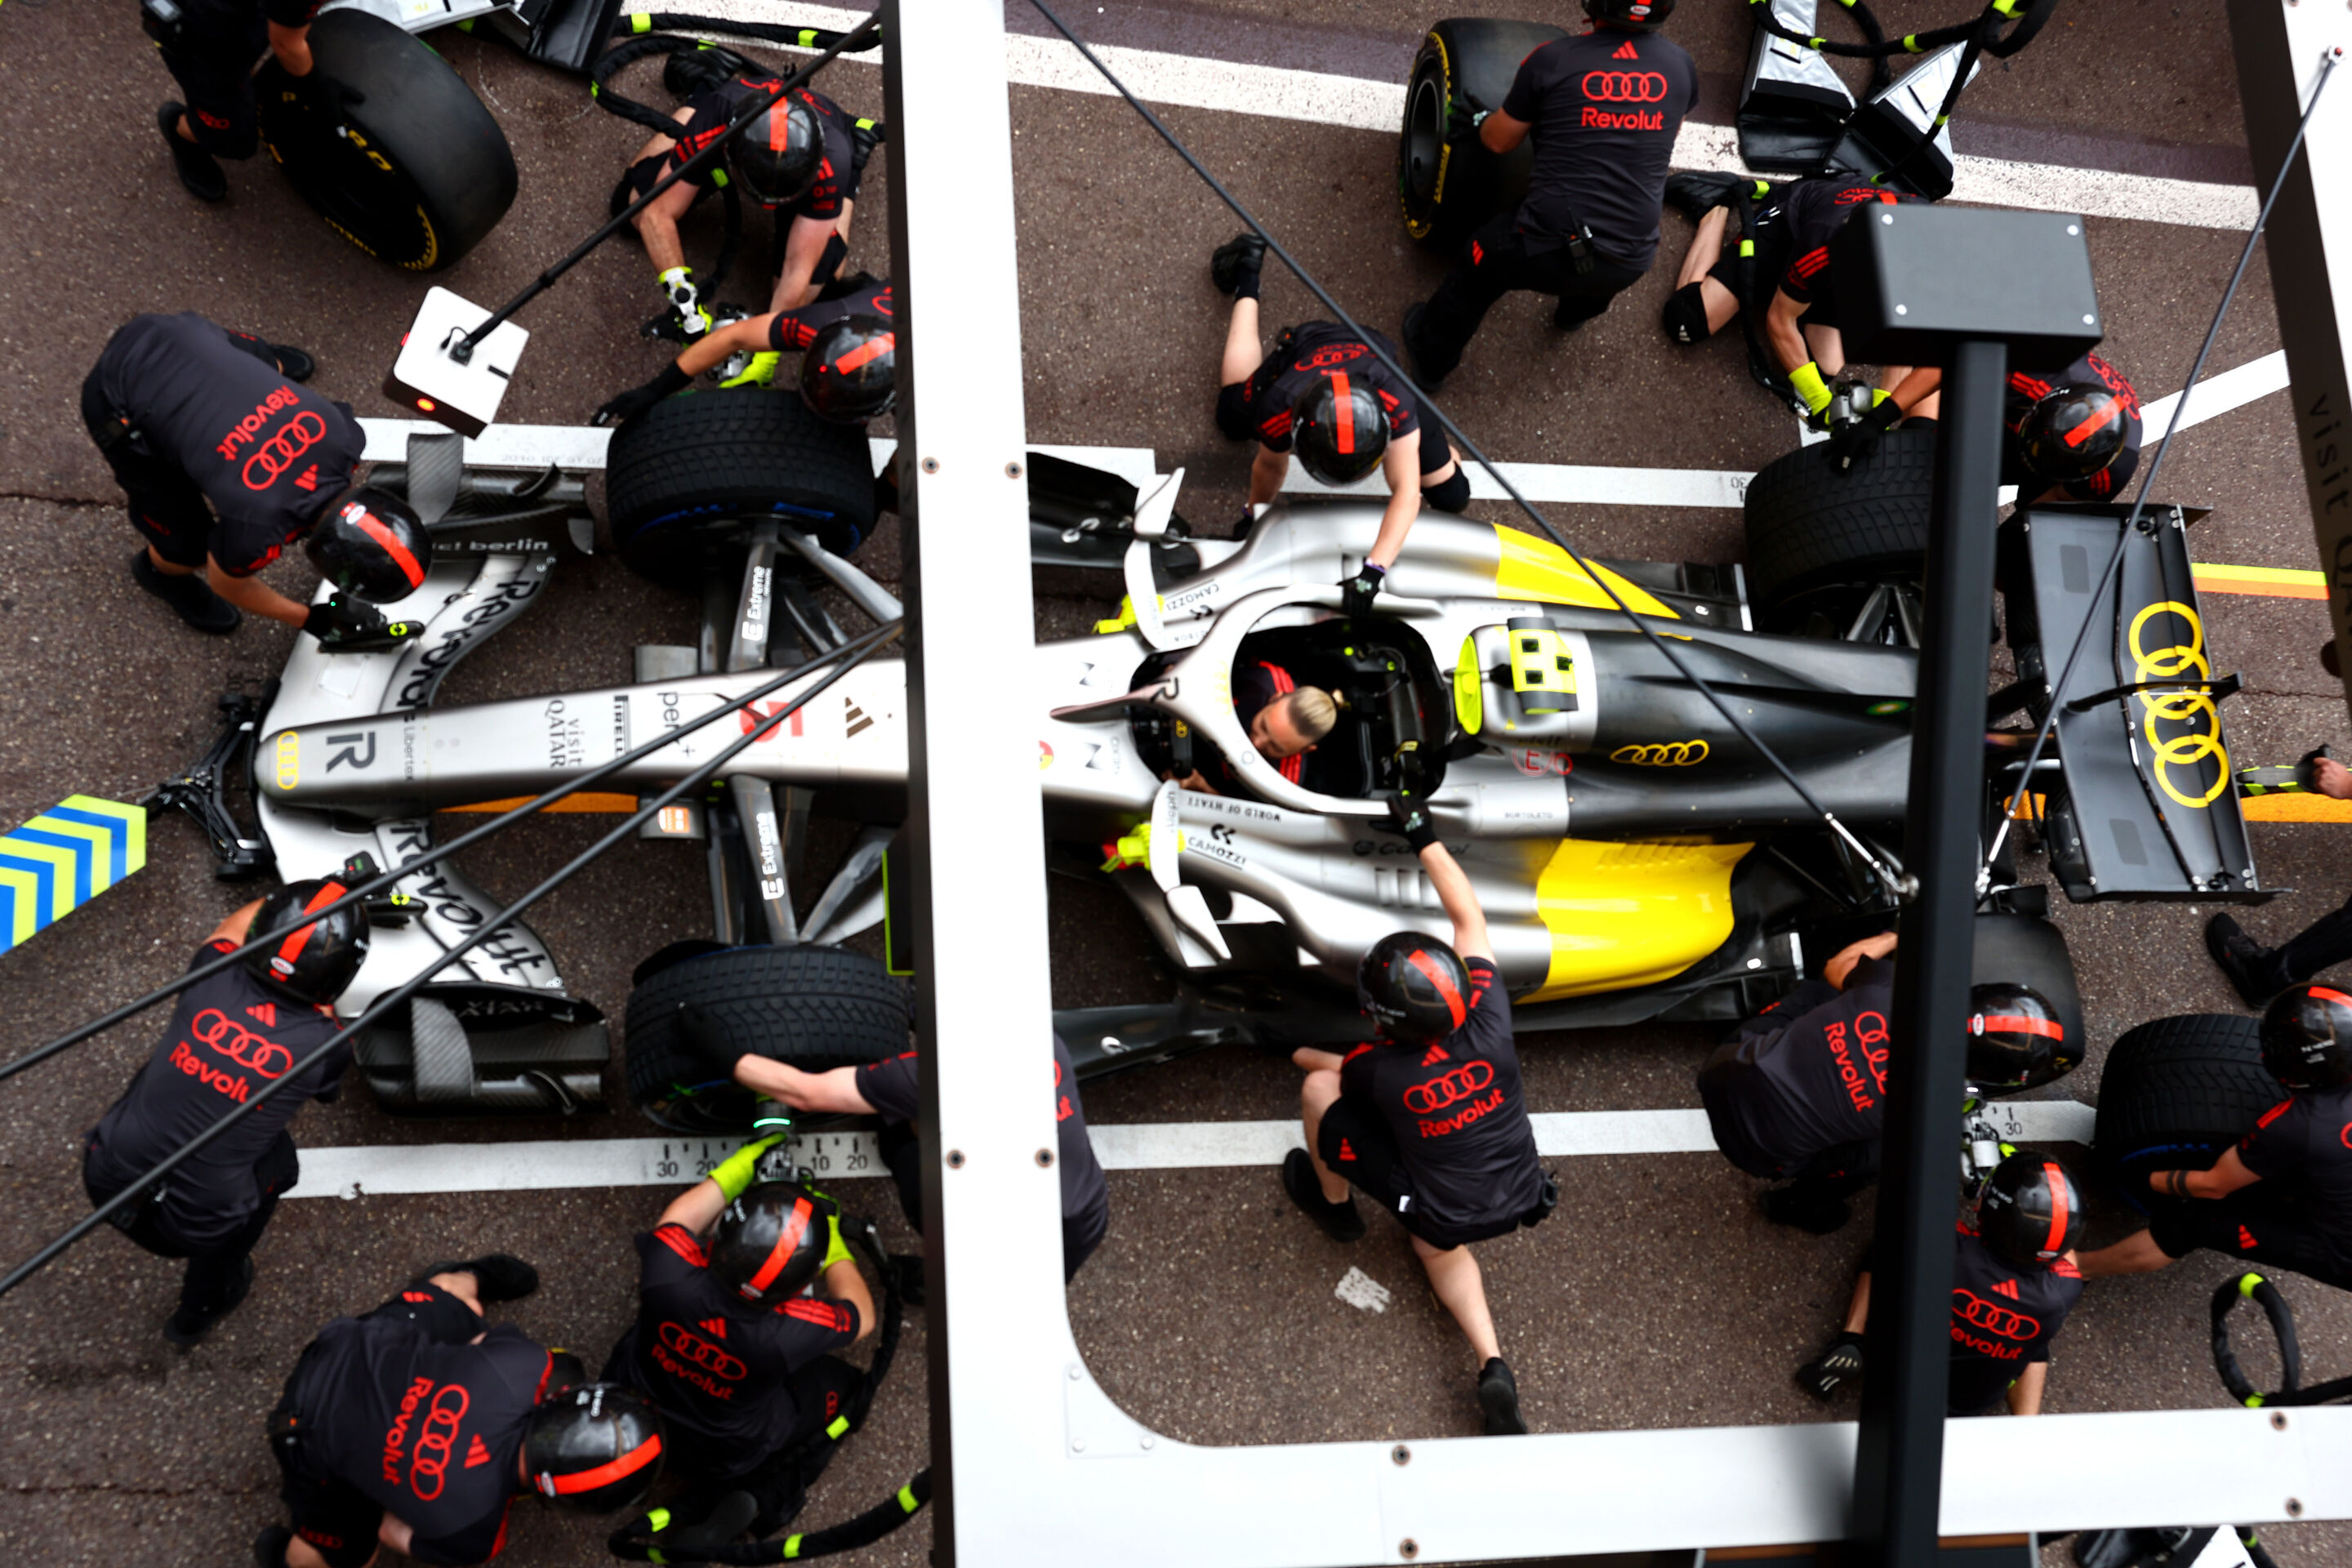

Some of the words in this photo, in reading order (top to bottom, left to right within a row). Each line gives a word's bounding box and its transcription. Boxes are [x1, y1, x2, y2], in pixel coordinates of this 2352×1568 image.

[1582, 106, 1664, 131] Revolut
[216, 385, 301, 461] Revolut
[2308, 393, 2350, 518] visit
[469, 538, 549, 551] berlin
[746, 566, 766, 618] Extreme
[1165, 582, 1220, 612] CAMOZZI
[397, 578, 540, 709] Revolu
[545, 699, 566, 768] QATAR
[568, 718, 586, 766] visit
[614, 694, 631, 758] PIRELL
[1187, 797, 1223, 813] HYATT
[1227, 804, 1241, 816] OF
[1244, 806, 1281, 823] WORLD
[755, 813, 778, 875] Extreme
[1188, 835, 1246, 866] CAMOZZI
[1824, 1020, 1875, 1112] Revolut
[1418, 1087, 1505, 1140] Revolut
[2004, 1122, 2023, 1138] 30
[657, 1161, 679, 1178] 30
[696, 1160, 718, 1176] 20
[811, 1156, 830, 1171] 10
[847, 1154, 868, 1170] 20
[1950, 1320, 2024, 1360] evolut
[651, 1342, 735, 1401] Revolut
[381, 1375, 435, 1488] Revolut
